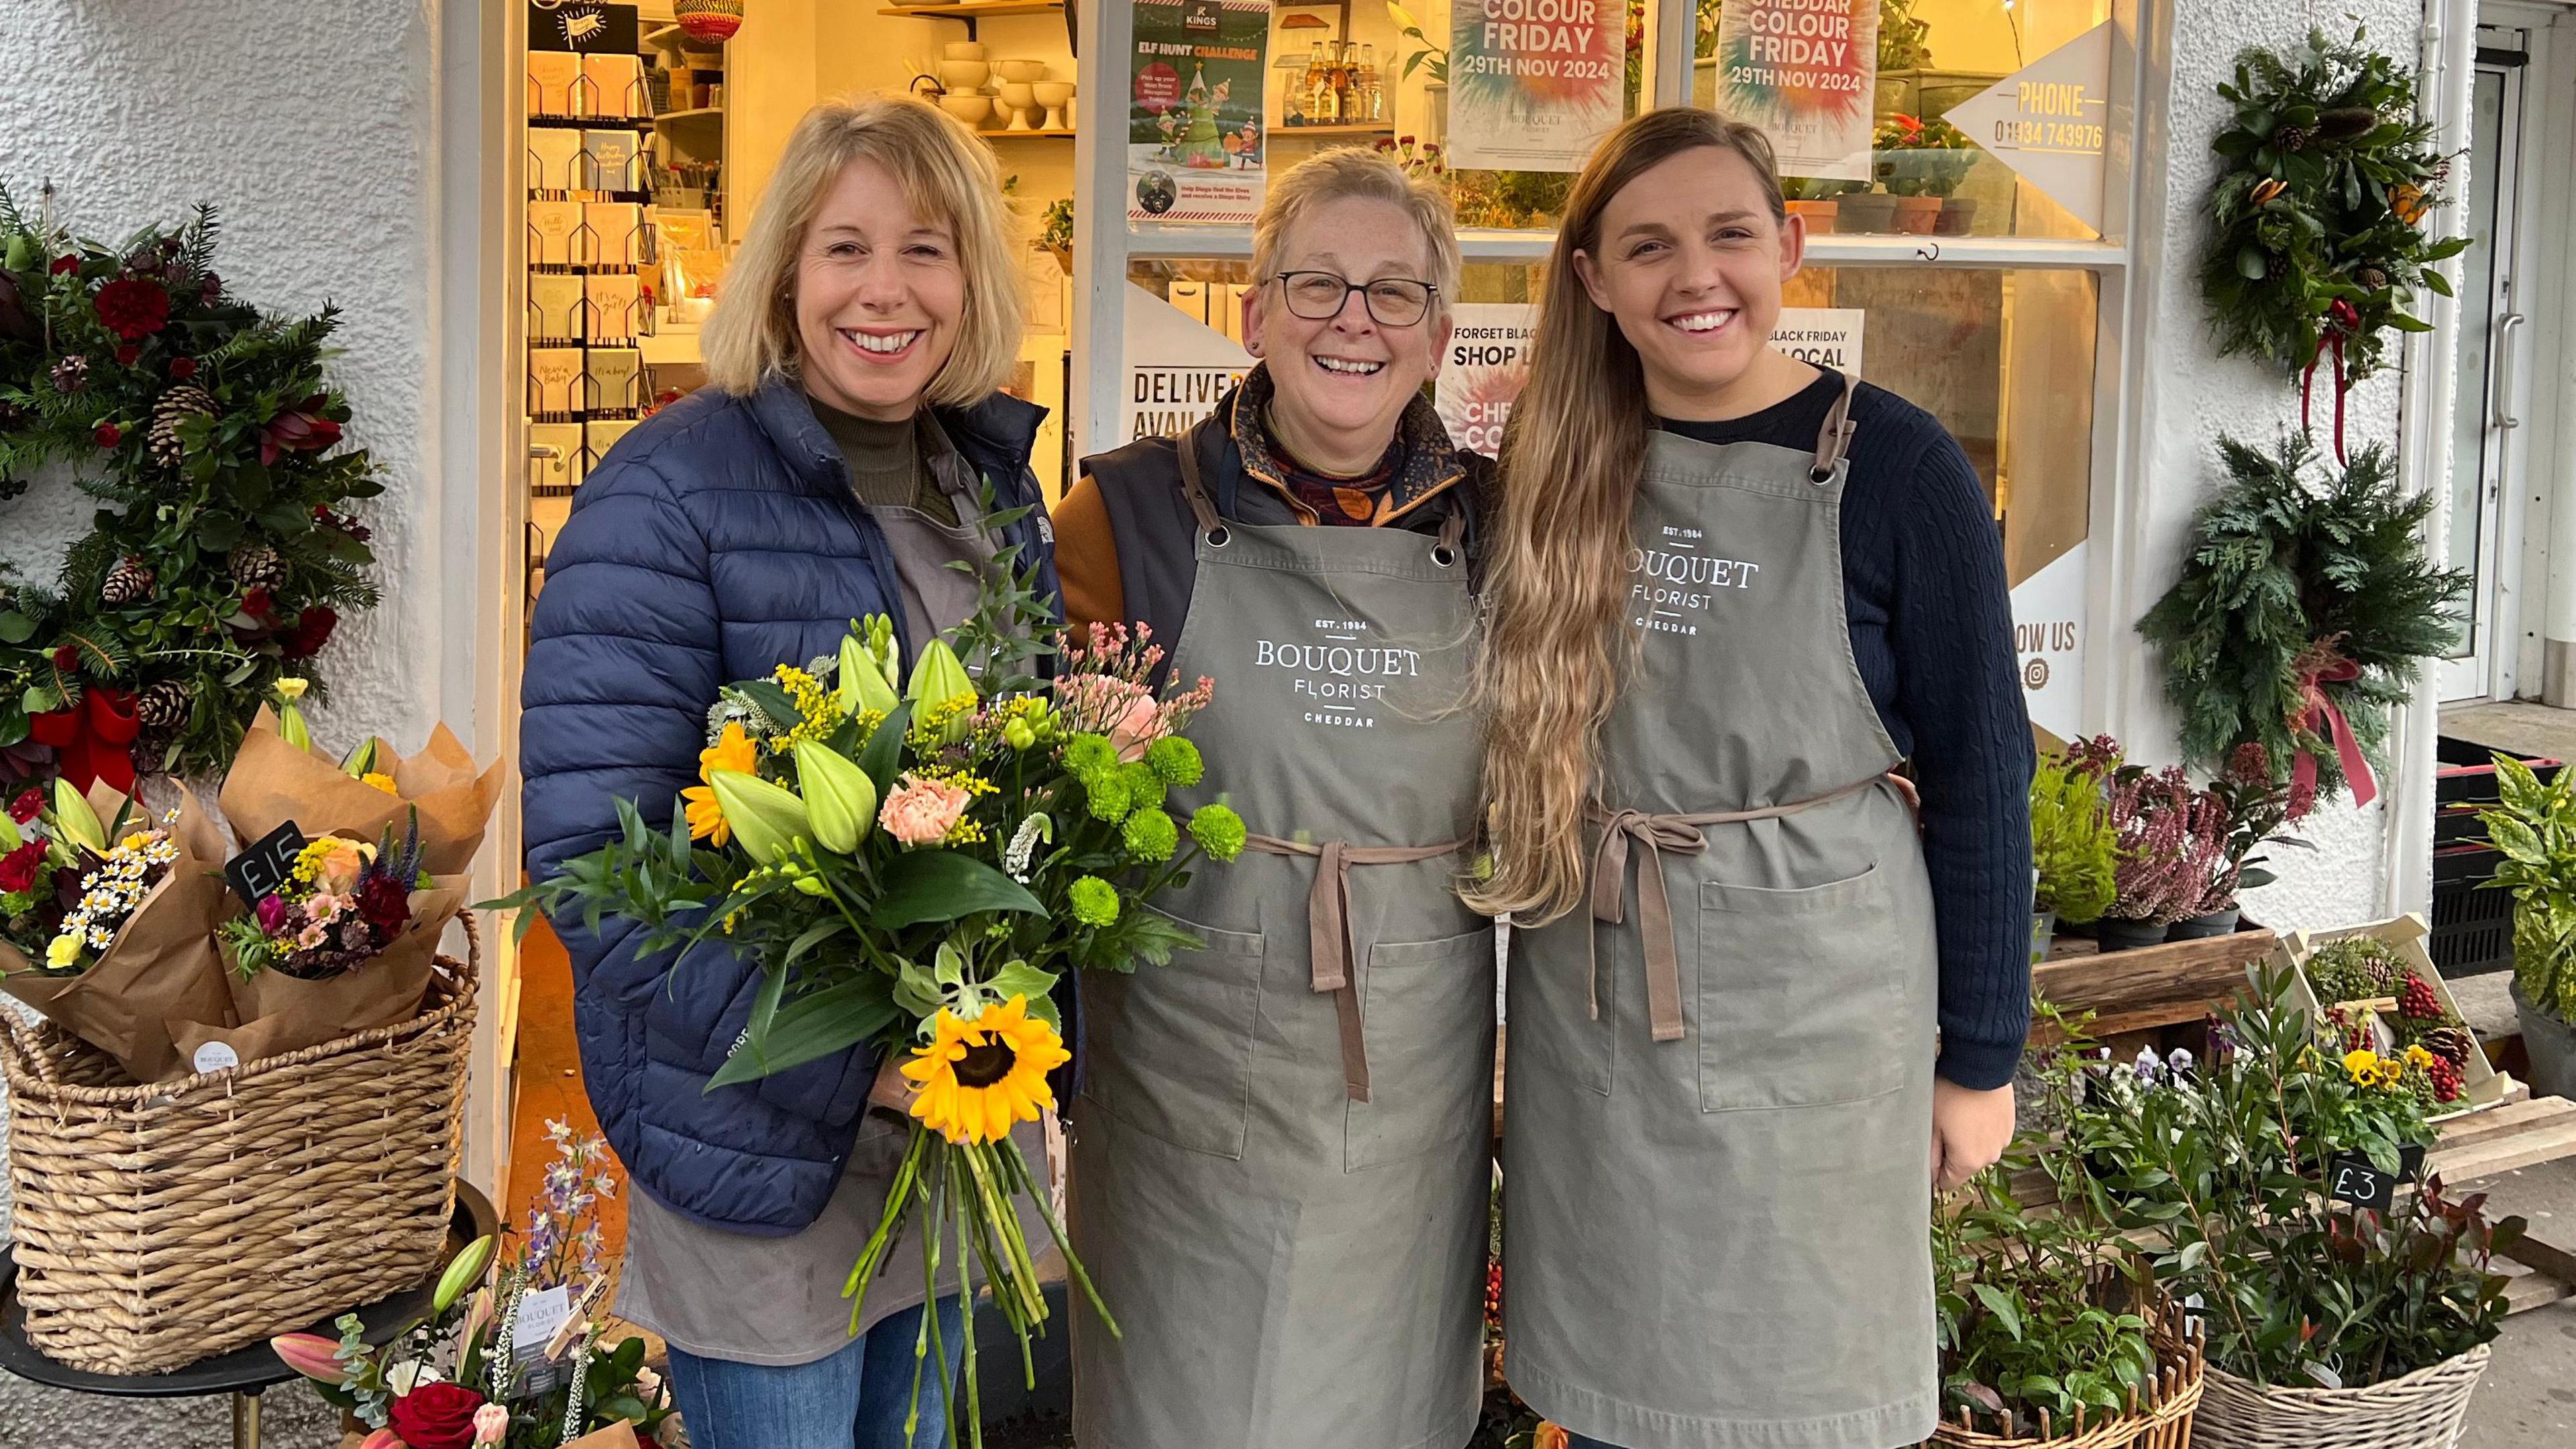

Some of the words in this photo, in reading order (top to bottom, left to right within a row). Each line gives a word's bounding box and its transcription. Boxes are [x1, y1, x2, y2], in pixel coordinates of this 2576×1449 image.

[1186, 16, 1217, 25] KINGS
[1484, 0, 1595, 24] COLOUR
[1750, 9, 1849, 40] COLOUR
[1483, 21, 1593, 54] FRIDAY
[1138, 42, 1158, 53] ELF
[1159, 44, 1192, 56] HUNT
[1194, 46, 1258, 60] CHALLENGE
[1750, 35, 1847, 67] FRIDAY
[1464, 55, 1511, 76] 29TH
[1516, 58, 1558, 77] NOV
[1563, 60, 1609, 79] 2024
[1731, 66, 1774, 86] 29TH
[1778, 71, 1817, 89] NOV
[1820, 72, 1862, 92] 2024
[2018, 82, 2084, 117] PHONE
[1511, 115, 1562, 125] BOUQUET
[1772, 123, 1817, 133] BOUQUET
[1995, 120, 2042, 145] 01934
[2047, 123, 2103, 148] 743976
[1454, 327, 1504, 339] FORGET
[1507, 328, 1536, 339] BLAC
[1807, 331, 1847, 342] FRIDAY
[1454, 346, 1516, 366] SHOP
[1782, 347, 1844, 366] OCAL
[1624, 547, 1759, 589] OUQUET
[1631, 584, 1712, 610] FLORIST
[1635, 617, 1697, 636] CHEDDAR
[2051, 621, 2076, 652] US
[1254, 640, 1420, 677] BOUQUET
[1294, 678, 1386, 700] FLORIST
[1304, 712, 1375, 728] CHEDDAR
[241, 833, 301, 899] £15
[2334, 1168, 2375, 1200] £3
[516, 1303, 564, 1326] BOUQUET
